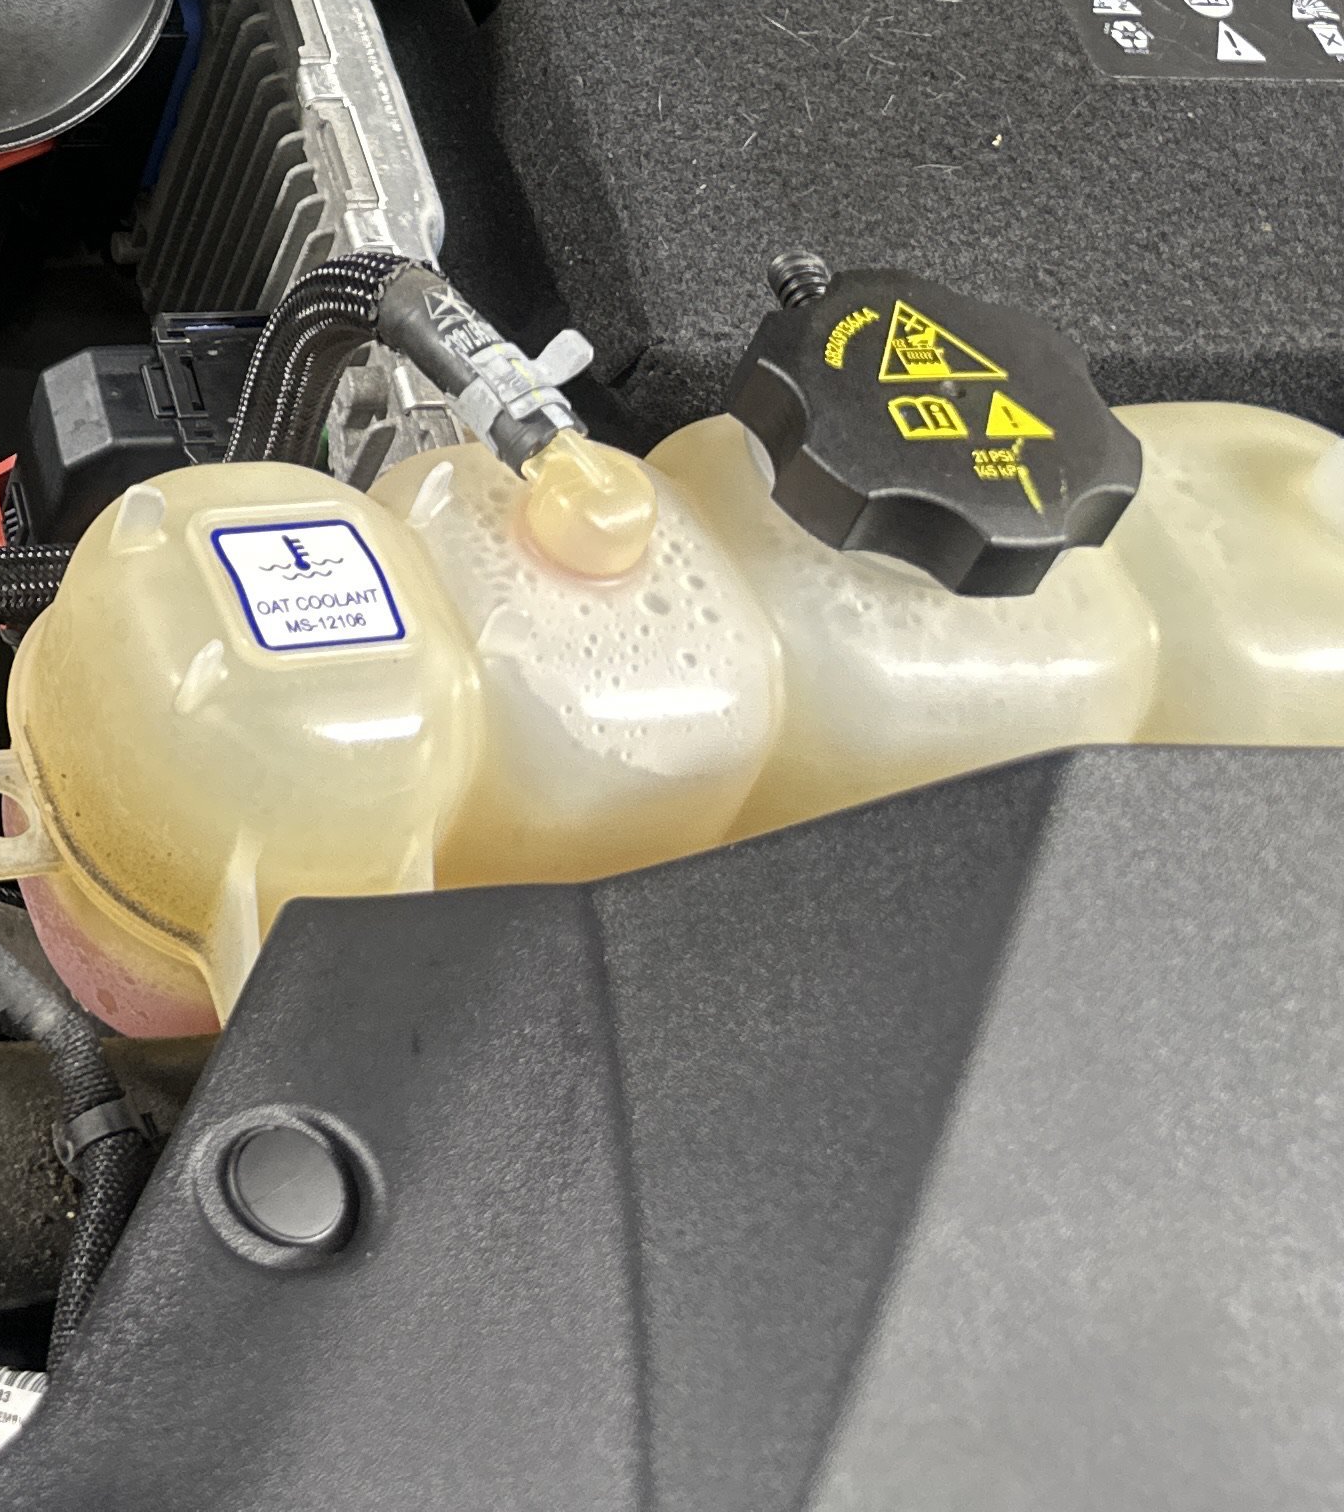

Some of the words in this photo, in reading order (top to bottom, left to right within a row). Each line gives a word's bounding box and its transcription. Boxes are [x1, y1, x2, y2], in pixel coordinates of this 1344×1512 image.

[257, 598, 291, 615] OAT
[295, 589, 379, 611] COOLANT
[285, 613, 367, 633] MS-12106
